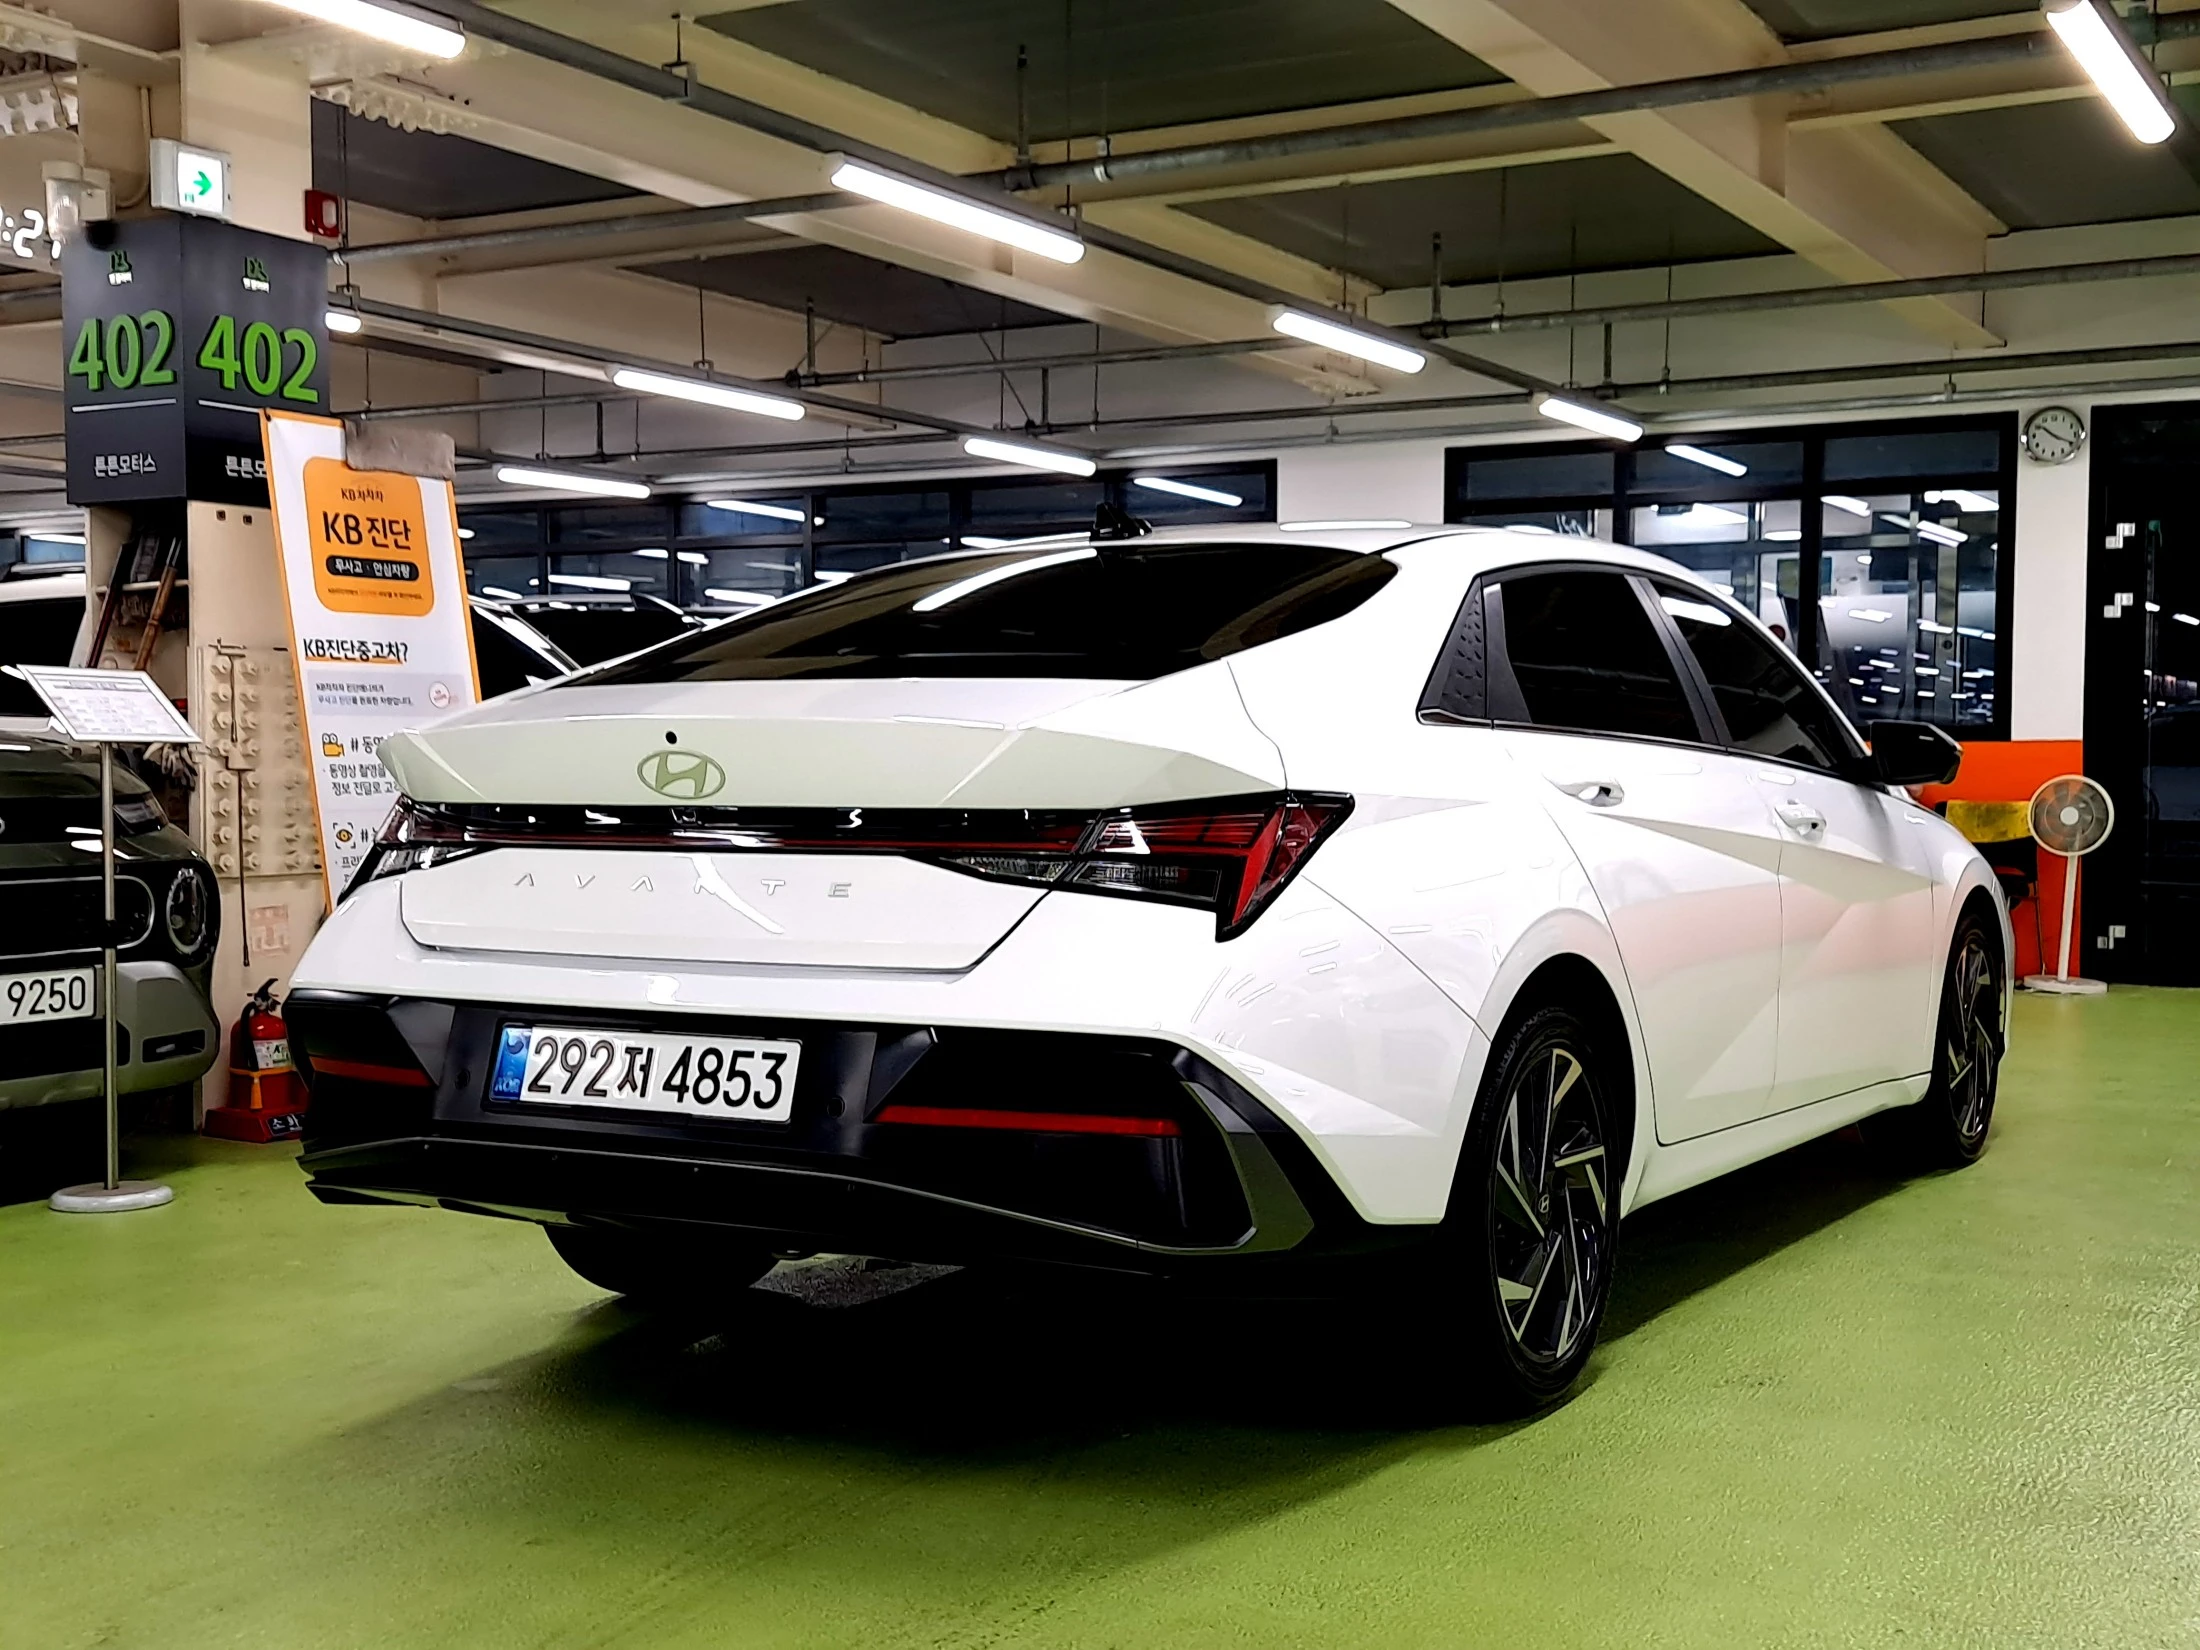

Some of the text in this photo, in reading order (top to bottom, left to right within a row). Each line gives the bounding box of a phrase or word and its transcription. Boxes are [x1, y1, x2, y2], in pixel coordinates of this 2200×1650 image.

[68, 309, 177, 391] 402
[197, 313, 320, 404] 402
[94, 453, 158, 477] 튼튼모터스
[322, 510, 412, 551] KB 진단
[303, 638, 409, 663] KB진단중고차?
[329, 763, 357, 779] 동영상
[331, 781, 351, 796] 정보
[7, 975, 86, 1017] 9250
[527, 1036, 788, 1110] 292저 4853
